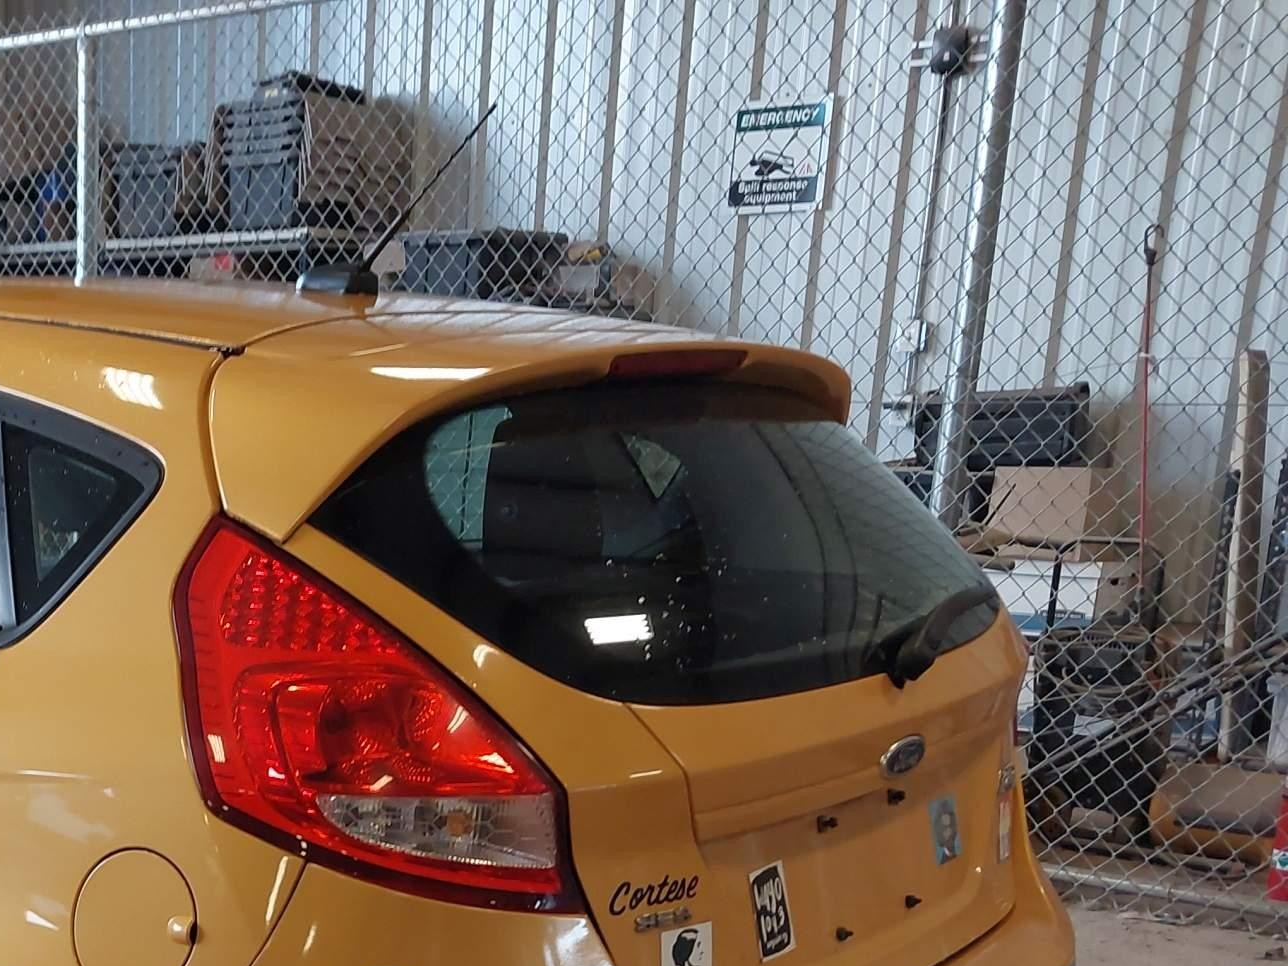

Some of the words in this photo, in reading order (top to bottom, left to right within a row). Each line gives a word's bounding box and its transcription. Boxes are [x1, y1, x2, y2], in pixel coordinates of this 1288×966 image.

[741, 108, 820, 127] EMERGENCY
[762, 179, 809, 193] response
[744, 190, 798, 205] equipment
[608, 874, 700, 916] Cortese
